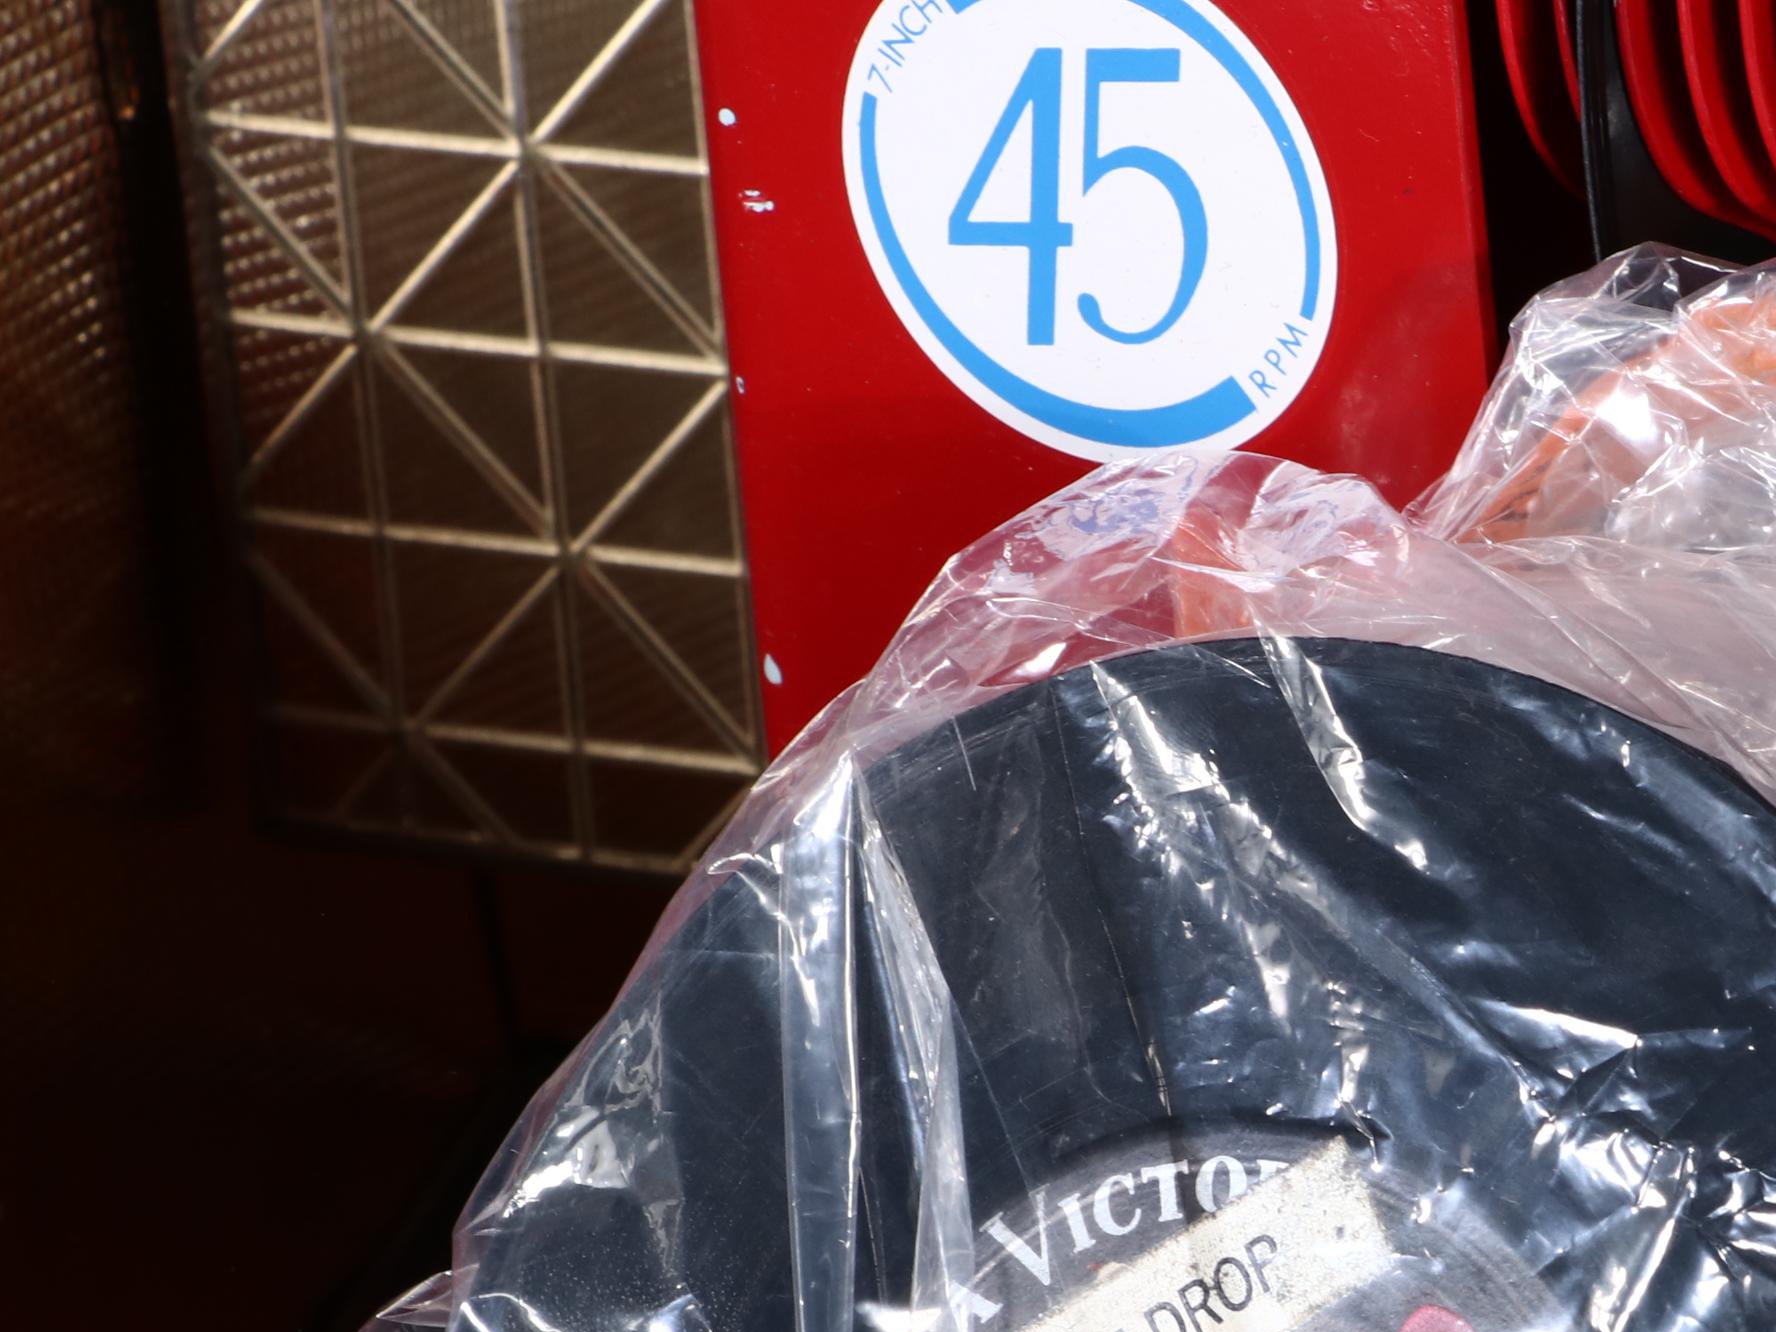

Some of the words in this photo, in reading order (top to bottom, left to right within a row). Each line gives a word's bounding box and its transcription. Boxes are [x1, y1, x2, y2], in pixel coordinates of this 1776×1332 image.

[867, 0, 943, 93] 7-INCH
[948, 47, 1208, 346] 45
[1248, 322, 1308, 398] RPM
